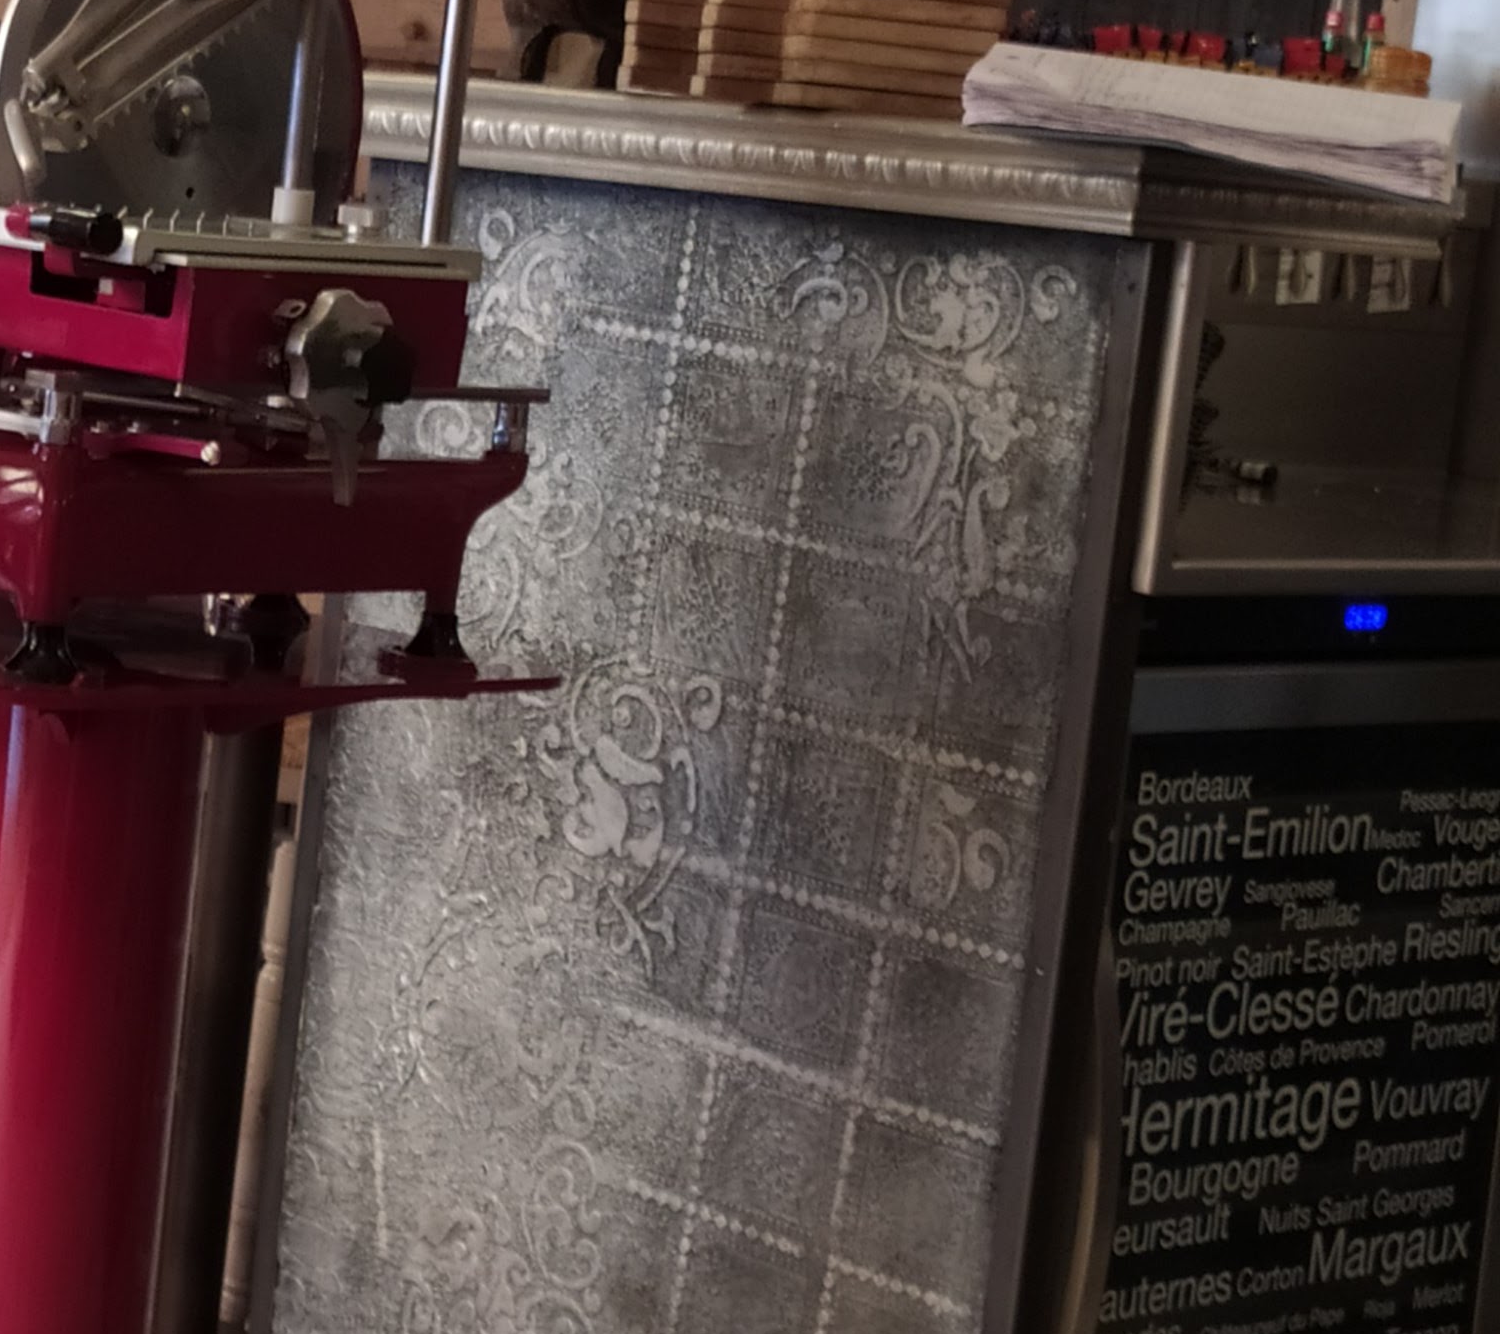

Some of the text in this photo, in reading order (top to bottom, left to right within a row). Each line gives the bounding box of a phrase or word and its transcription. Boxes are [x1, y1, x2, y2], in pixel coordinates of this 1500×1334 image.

[1138, 769, 1253, 806] Bordeaux
[1129, 803, 1373, 867] Saint-Emilion
[1124, 870, 1232, 916] Gevrey
[1280, 900, 1362, 931] Pauillac
[1118, 917, 1232, 946] Champagne
[1403, 919, 1500, 965] Riesling
[1116, 956, 1172, 987] Pinot
[1177, 951, 1222, 984] noir
[1345, 977, 1500, 1023] Chardonnay
[1123, 1048, 1197, 1087] hablis
[1269, 1042, 1295, 1070] de
[1300, 1037, 1386, 1065] Provence
[1411, 1013, 1497, 1051] Pomerol
[1370, 1076, 1491, 1122] Vouvray
[1128, 1125, 1468, 1206] Bourgogne Pommard
[1112, 1185, 1456, 1257] eursault Nuits Saint Georges
[1099, 1220, 1472, 1323] auternes Corton Margaux
